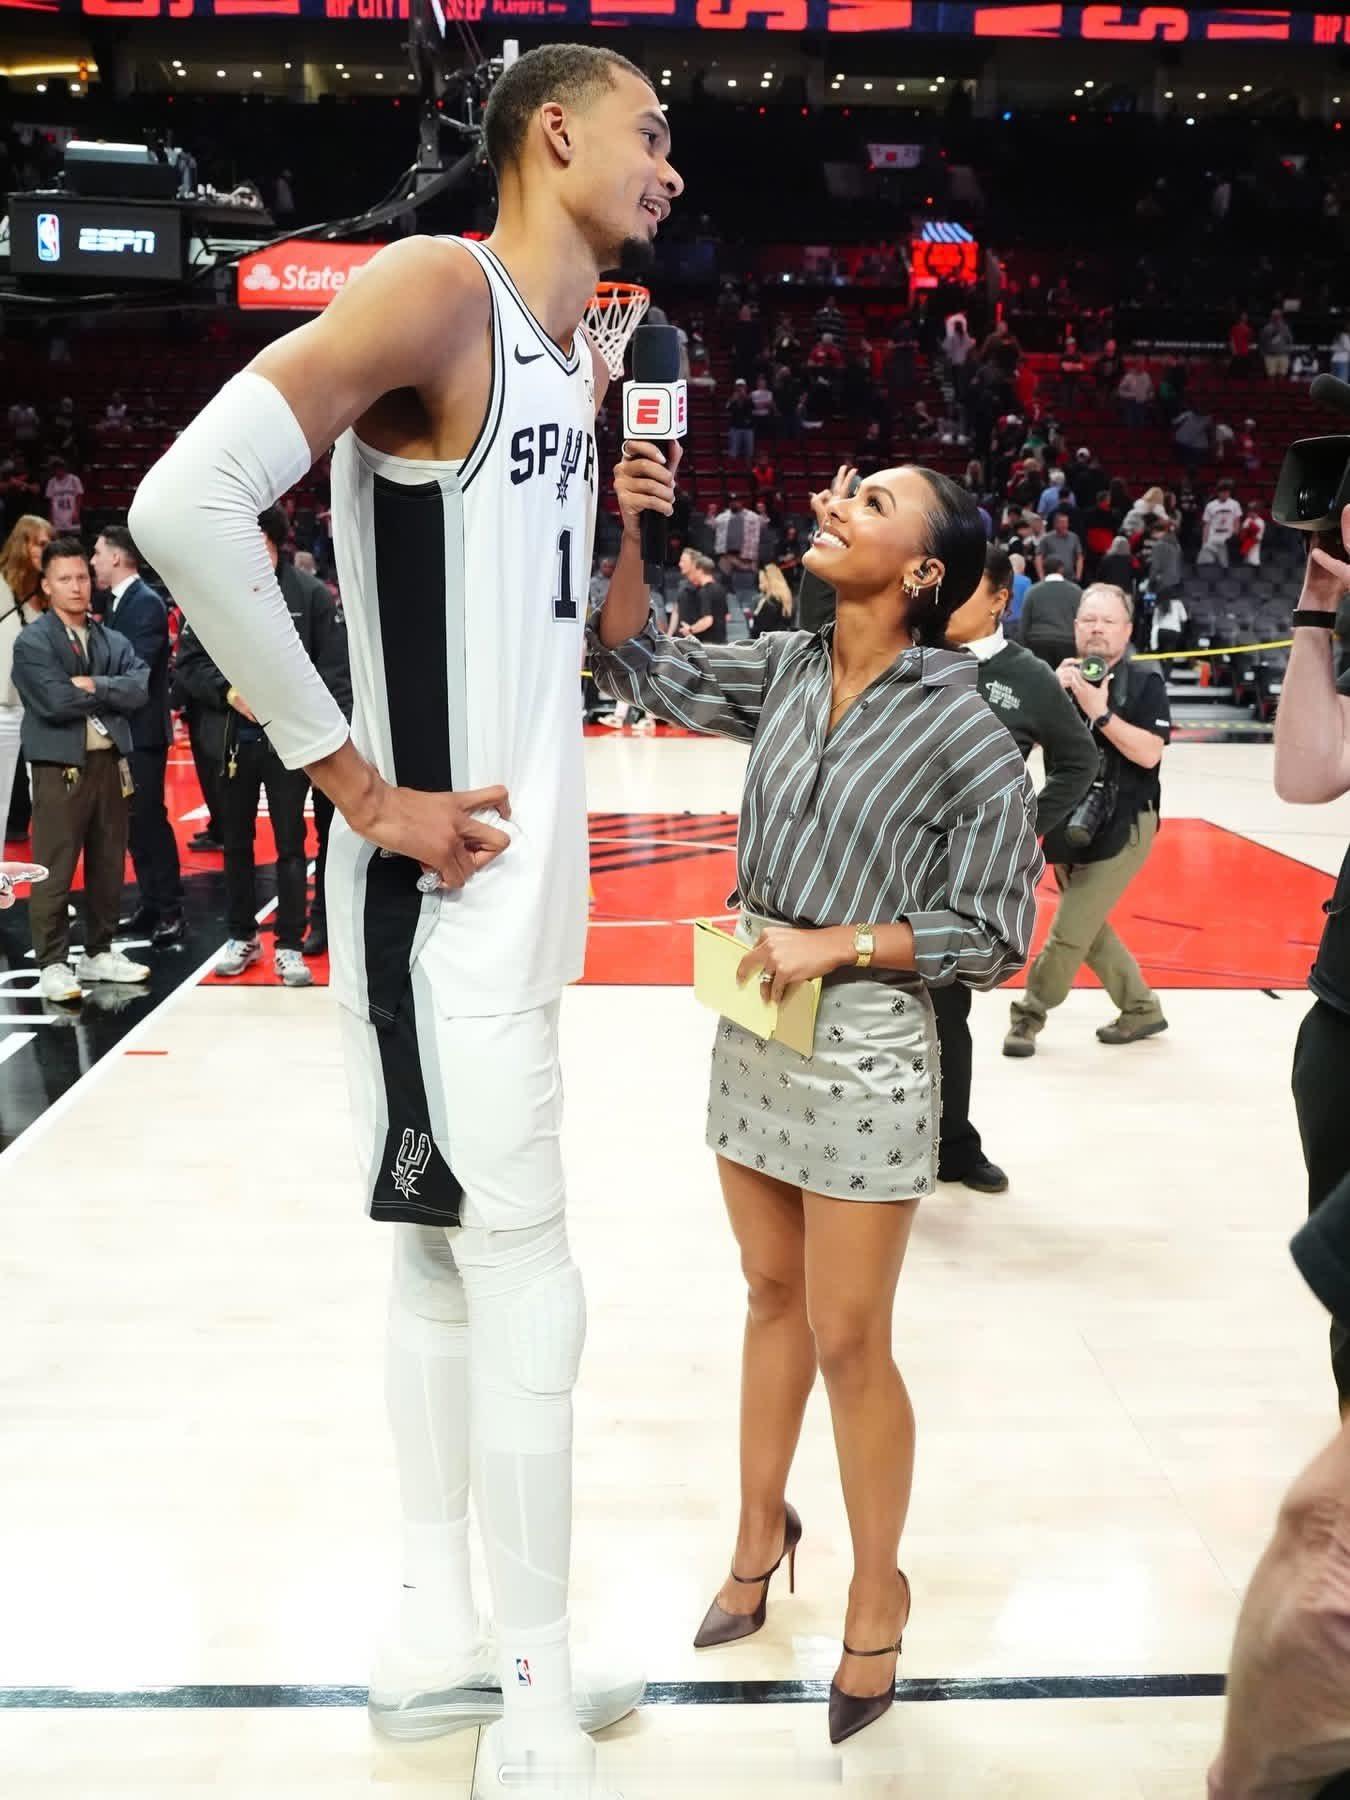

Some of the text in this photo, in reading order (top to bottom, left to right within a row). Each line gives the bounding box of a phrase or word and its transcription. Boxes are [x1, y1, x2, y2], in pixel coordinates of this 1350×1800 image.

[79, 228, 155, 254] ESPN
[282, 264, 346, 291] State
[510, 423, 595, 505] SPUR
[553, 527, 579, 623] 1
